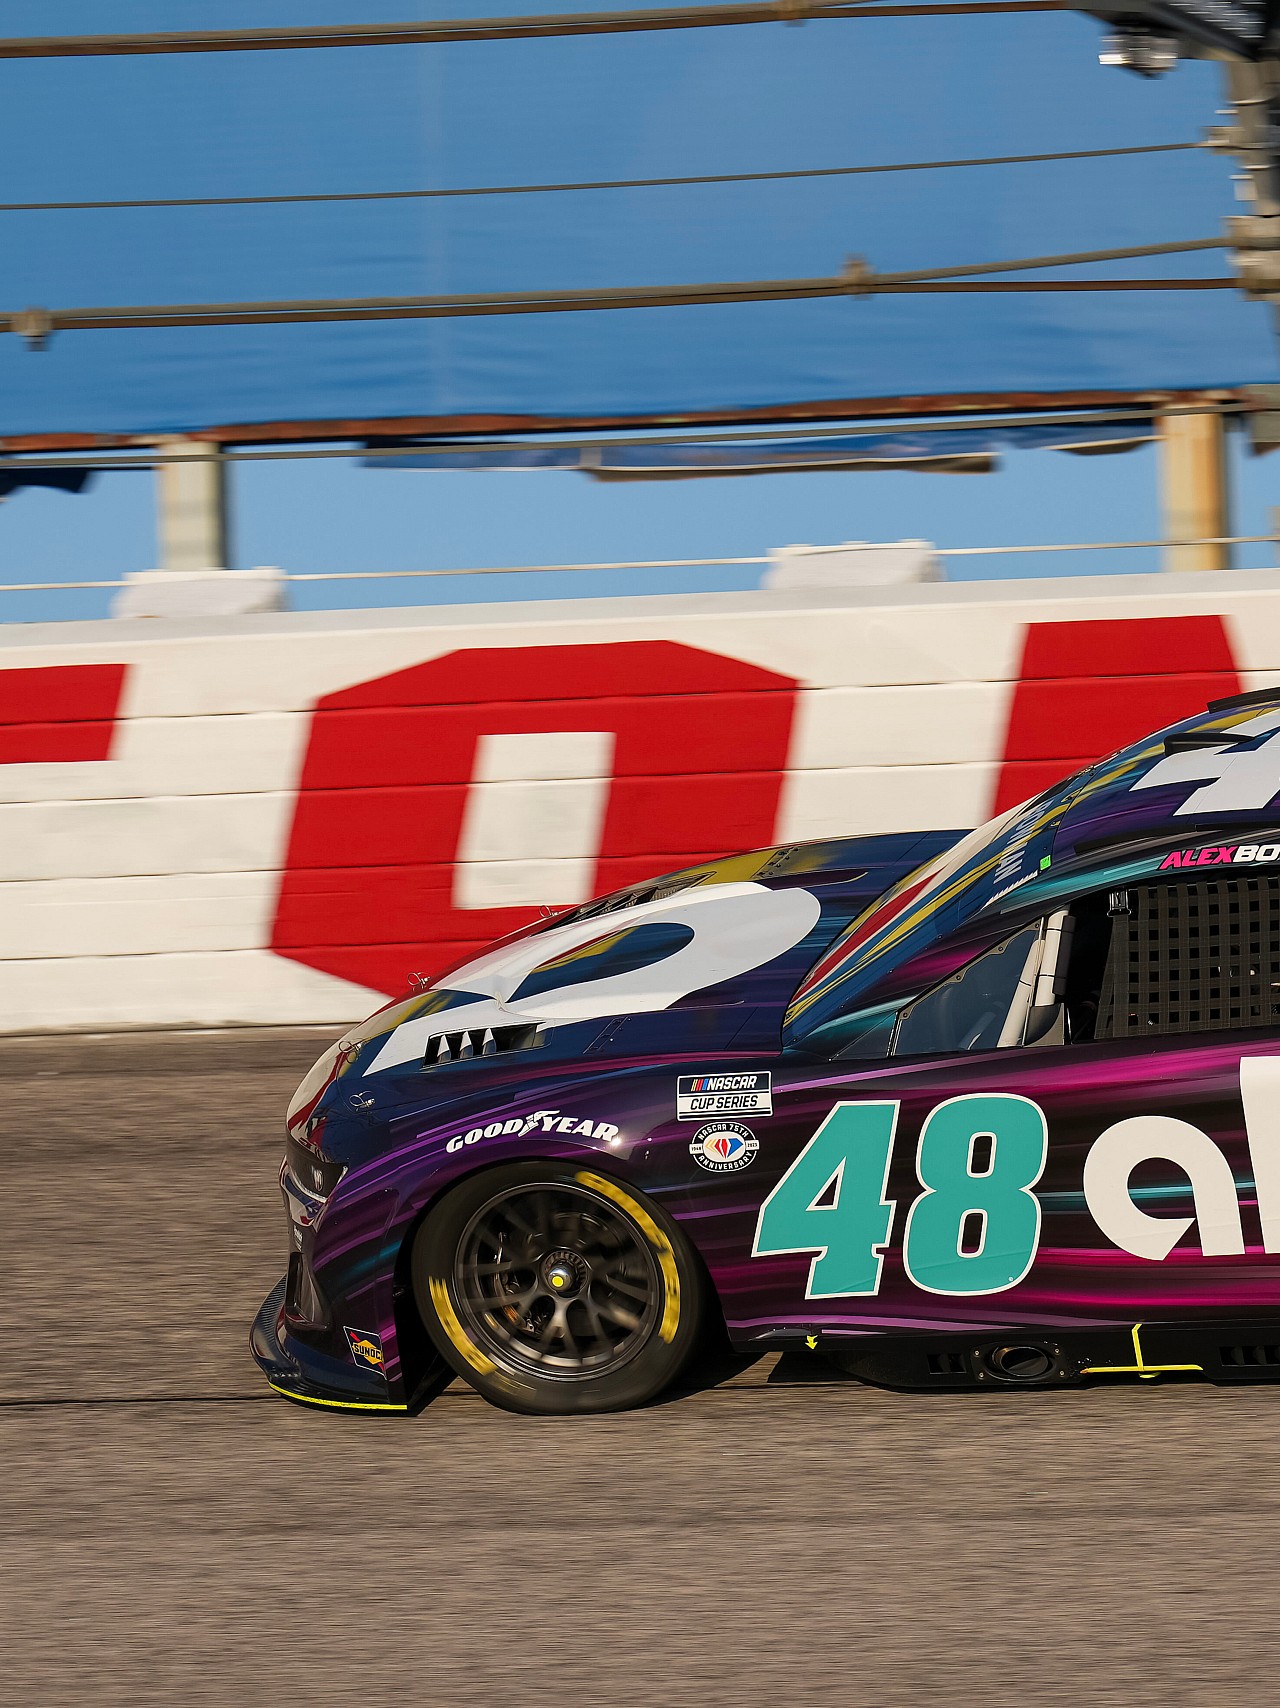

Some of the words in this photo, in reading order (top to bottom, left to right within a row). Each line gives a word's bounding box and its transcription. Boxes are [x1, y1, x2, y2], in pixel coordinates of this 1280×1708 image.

[1160, 846, 1238, 870] ALEX
[706, 1075, 759, 1092] NASCAR
[690, 1097, 715, 1110] CUP
[716, 1095, 759, 1109] SERIES
[446, 1110, 620, 1153] GOODYEAR
[697, 1123, 727, 1141] NASCAR
[728, 1123, 750, 1139] 75TH
[698, 1151, 753, 1170] ANNIVERSARY
[751, 1092, 1048, 1300] 48
